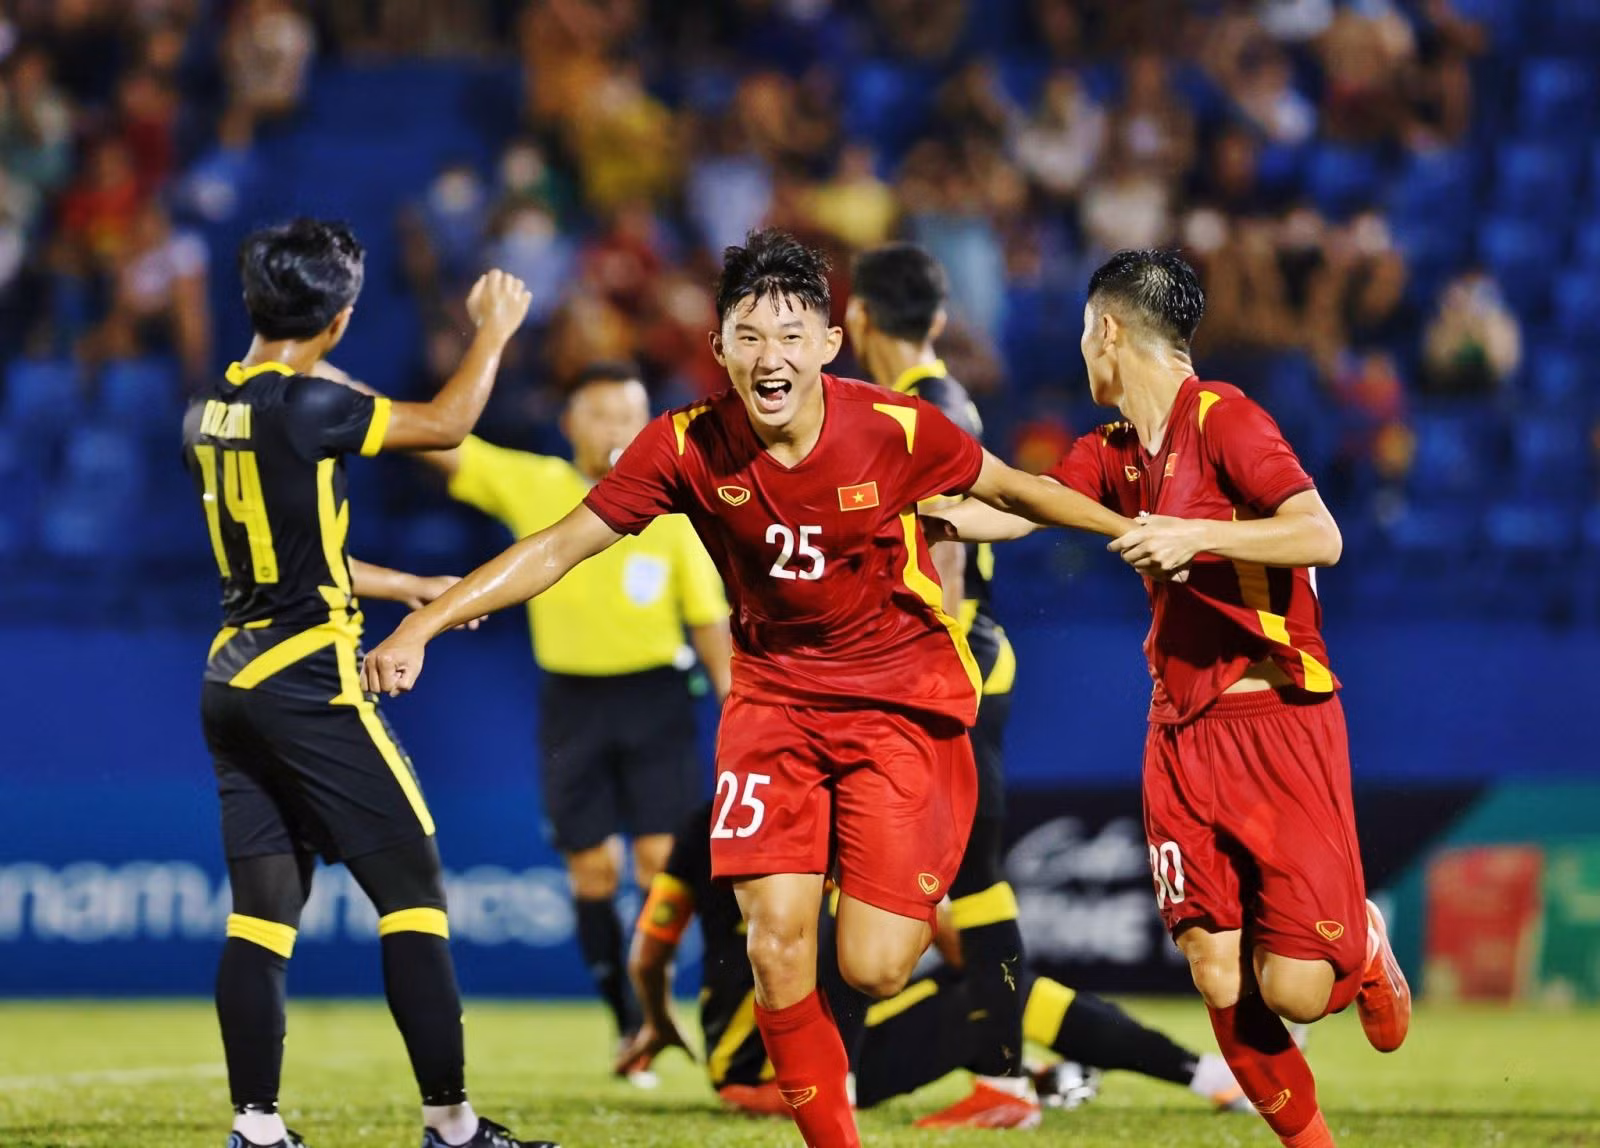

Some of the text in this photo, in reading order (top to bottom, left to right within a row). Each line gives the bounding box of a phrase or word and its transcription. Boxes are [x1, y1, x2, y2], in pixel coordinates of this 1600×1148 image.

[194, 445, 279, 583] 14
[765, 523, 825, 581] 25
[710, 770, 771, 839] 25
